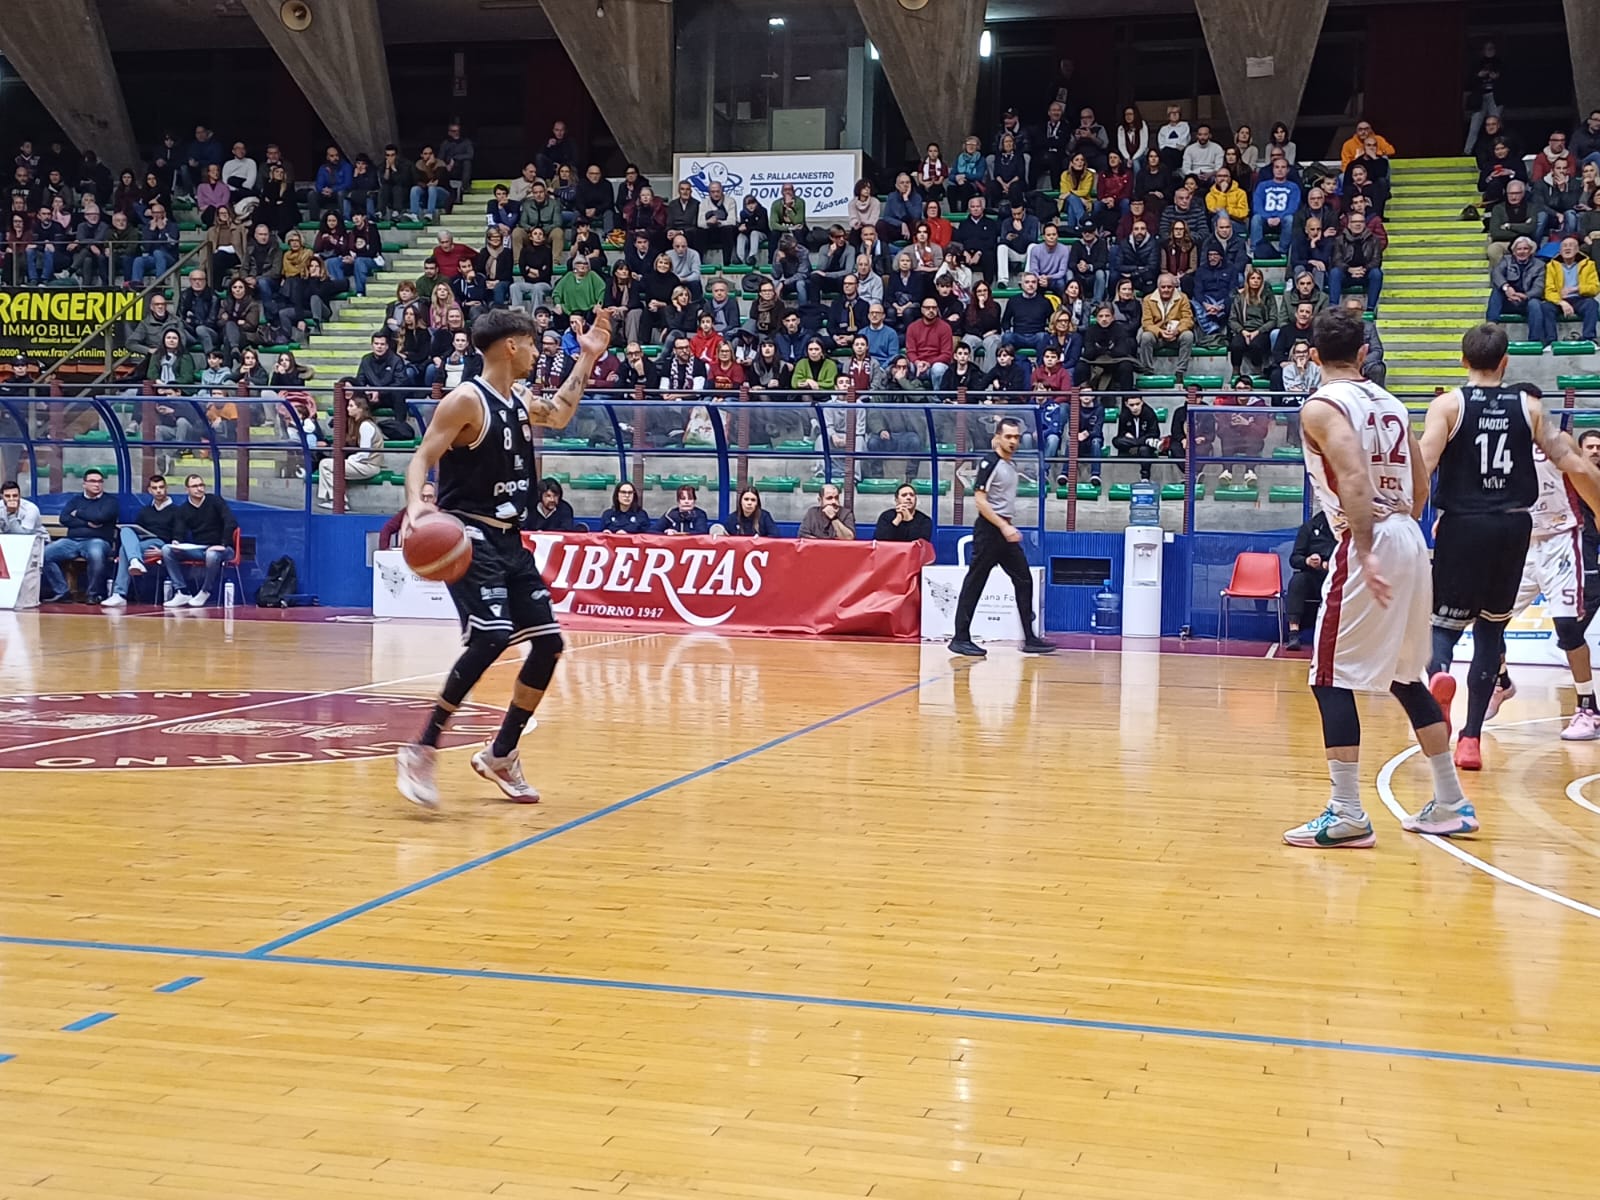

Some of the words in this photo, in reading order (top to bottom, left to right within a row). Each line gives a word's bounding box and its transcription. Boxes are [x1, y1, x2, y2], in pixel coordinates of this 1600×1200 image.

[750, 173, 765, 181] A.S.
[767, 171, 835, 180] PALLACANESTRO
[750, 188, 779, 199] DON
[793, 187, 834, 198] OSCO
[1265, 192, 1287, 211] 63
[812, 196, 849, 213] Livorno
[1478, 417, 1509, 430] HADZIC
[503, 427, 512, 450] 8
[1366, 410, 1407, 466] 12
[1475, 433, 1513, 474] 14
[529, 533, 769, 626] LIBERTAS
[1562, 589, 1576, 606] 5
[577, 603, 635, 617] LIVORNO
[637, 607, 664, 618] 1947
